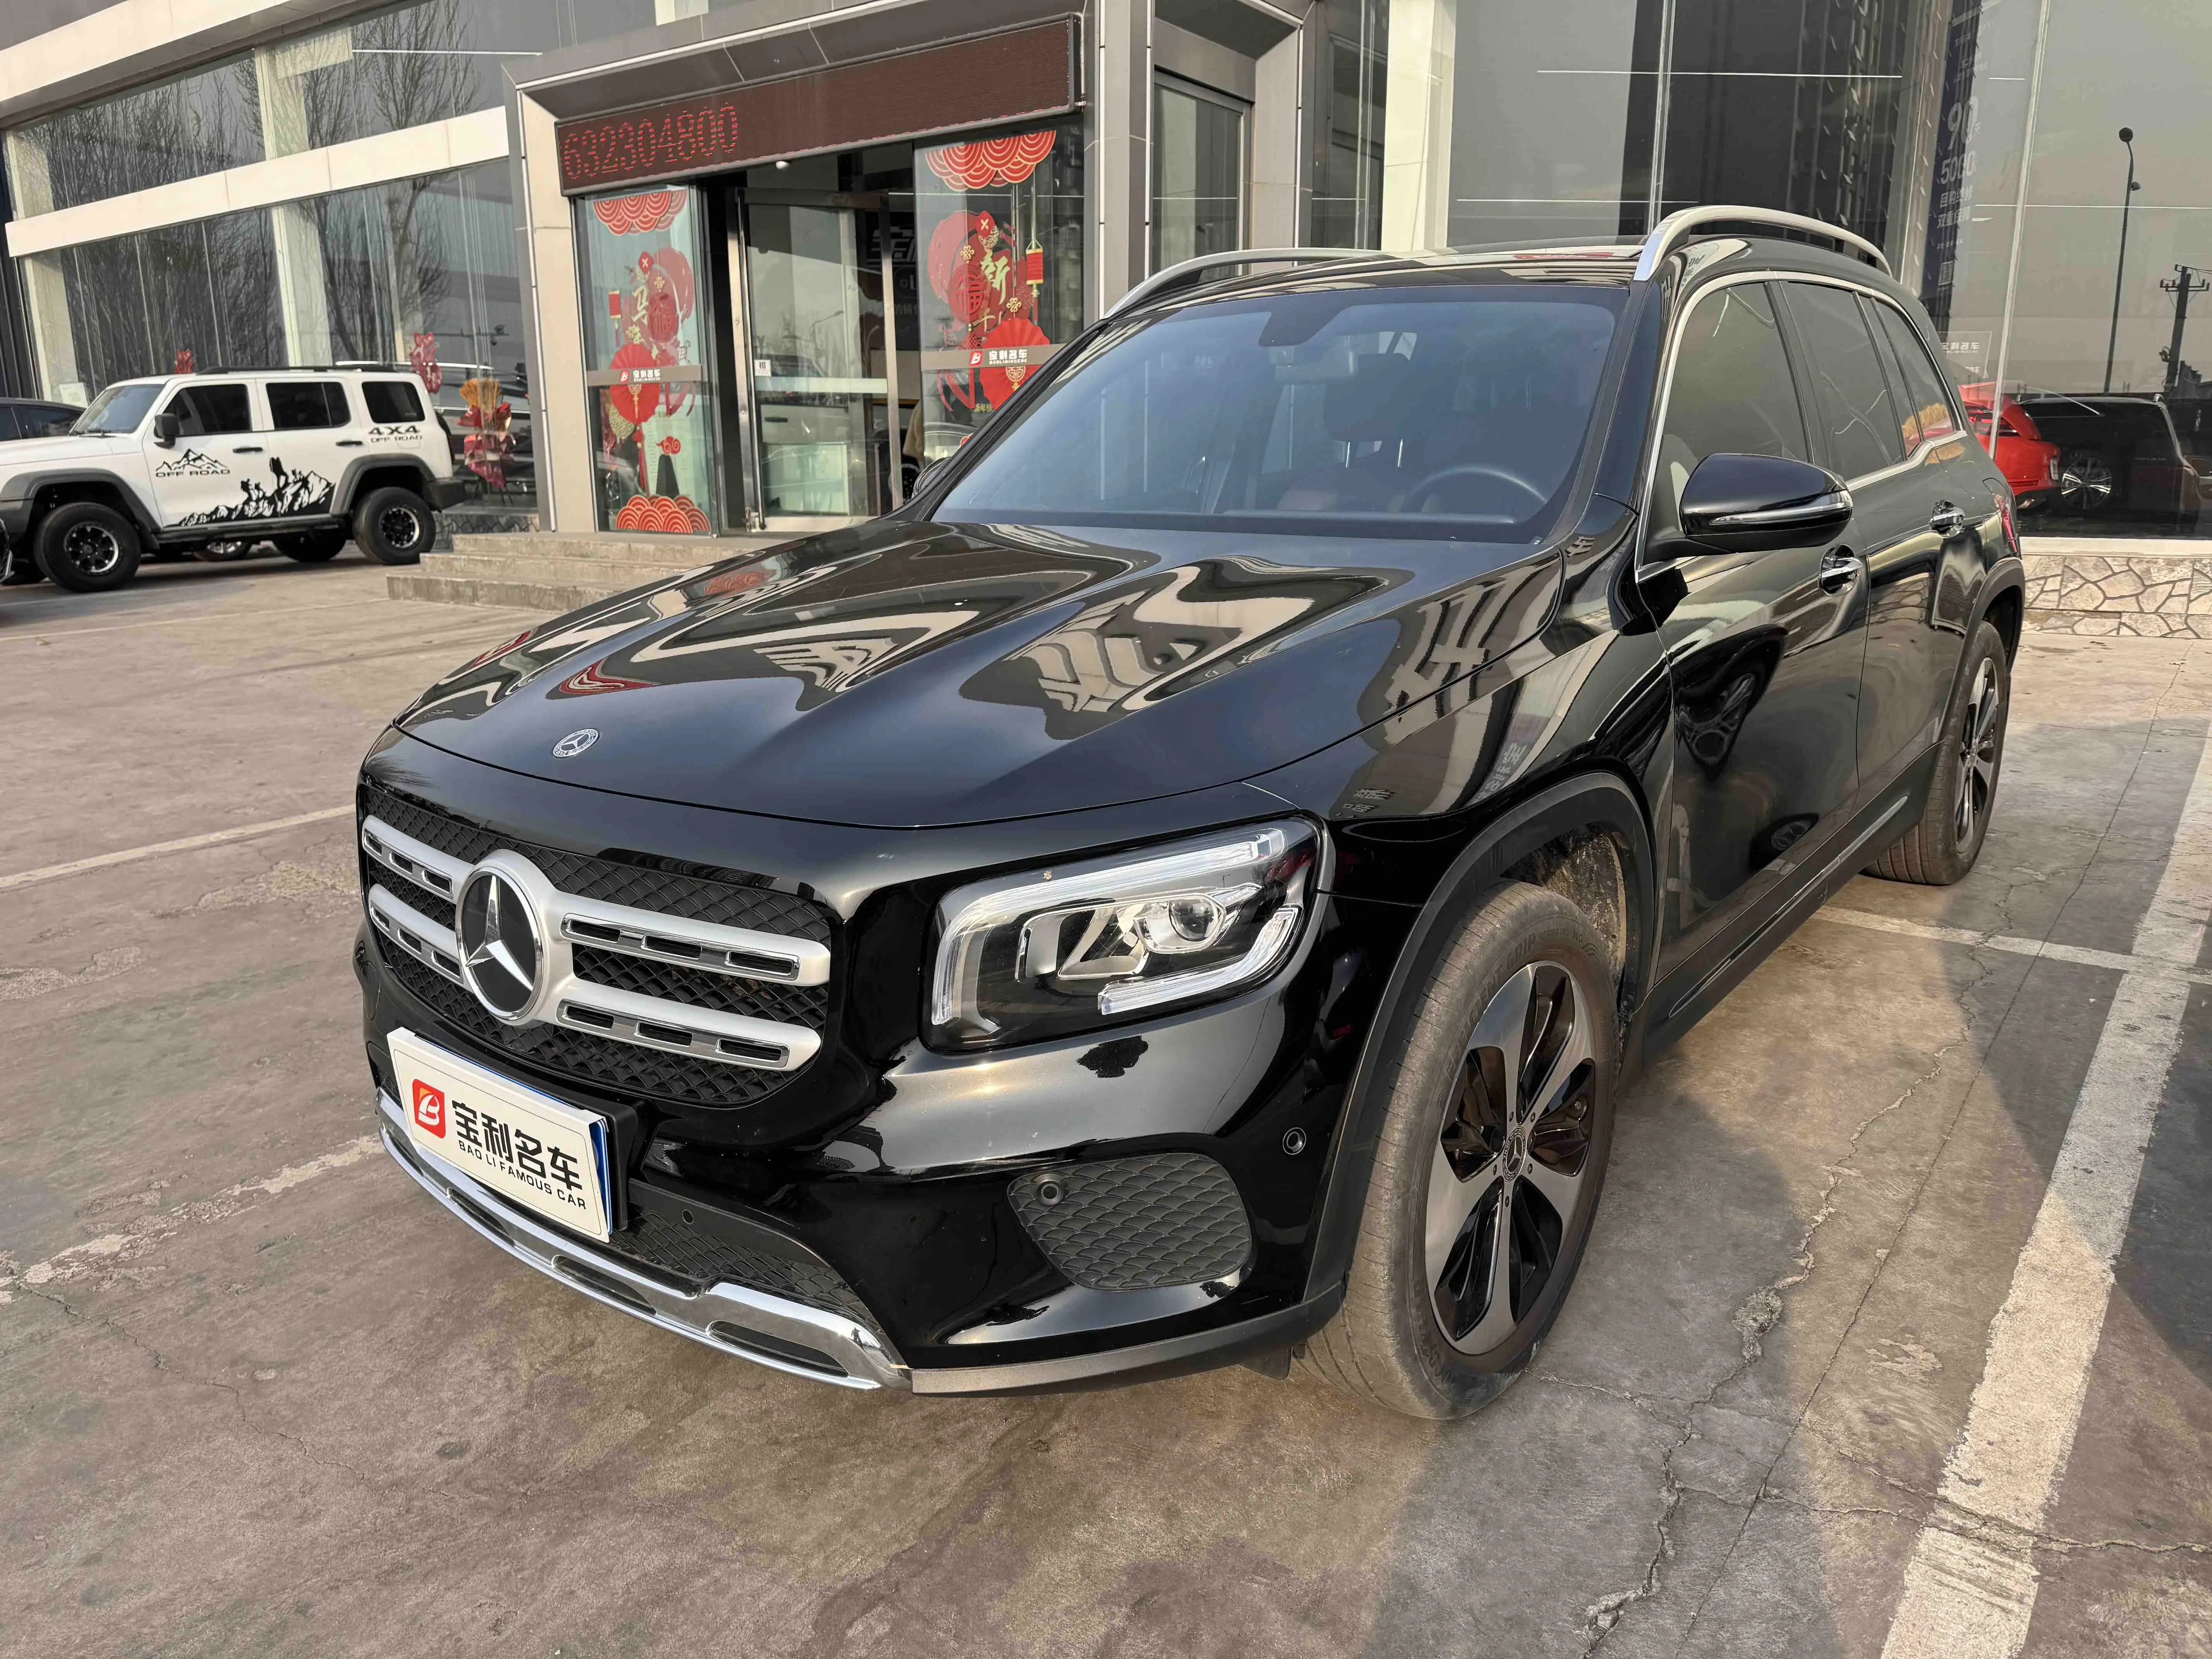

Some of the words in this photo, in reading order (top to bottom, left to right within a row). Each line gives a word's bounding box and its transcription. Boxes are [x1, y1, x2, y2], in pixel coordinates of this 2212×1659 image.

[563, 103, 738, 180] 632304800
[989, 349, 1027, 360] 宝利名车
[452, 1100, 583, 1192] 宝利名车
[459, 1140, 483, 1160] BAO
[487, 1152, 496, 1168] LI
[500, 1161, 552, 1195] FAMOUS
[557, 1188, 586, 1210] CAR
